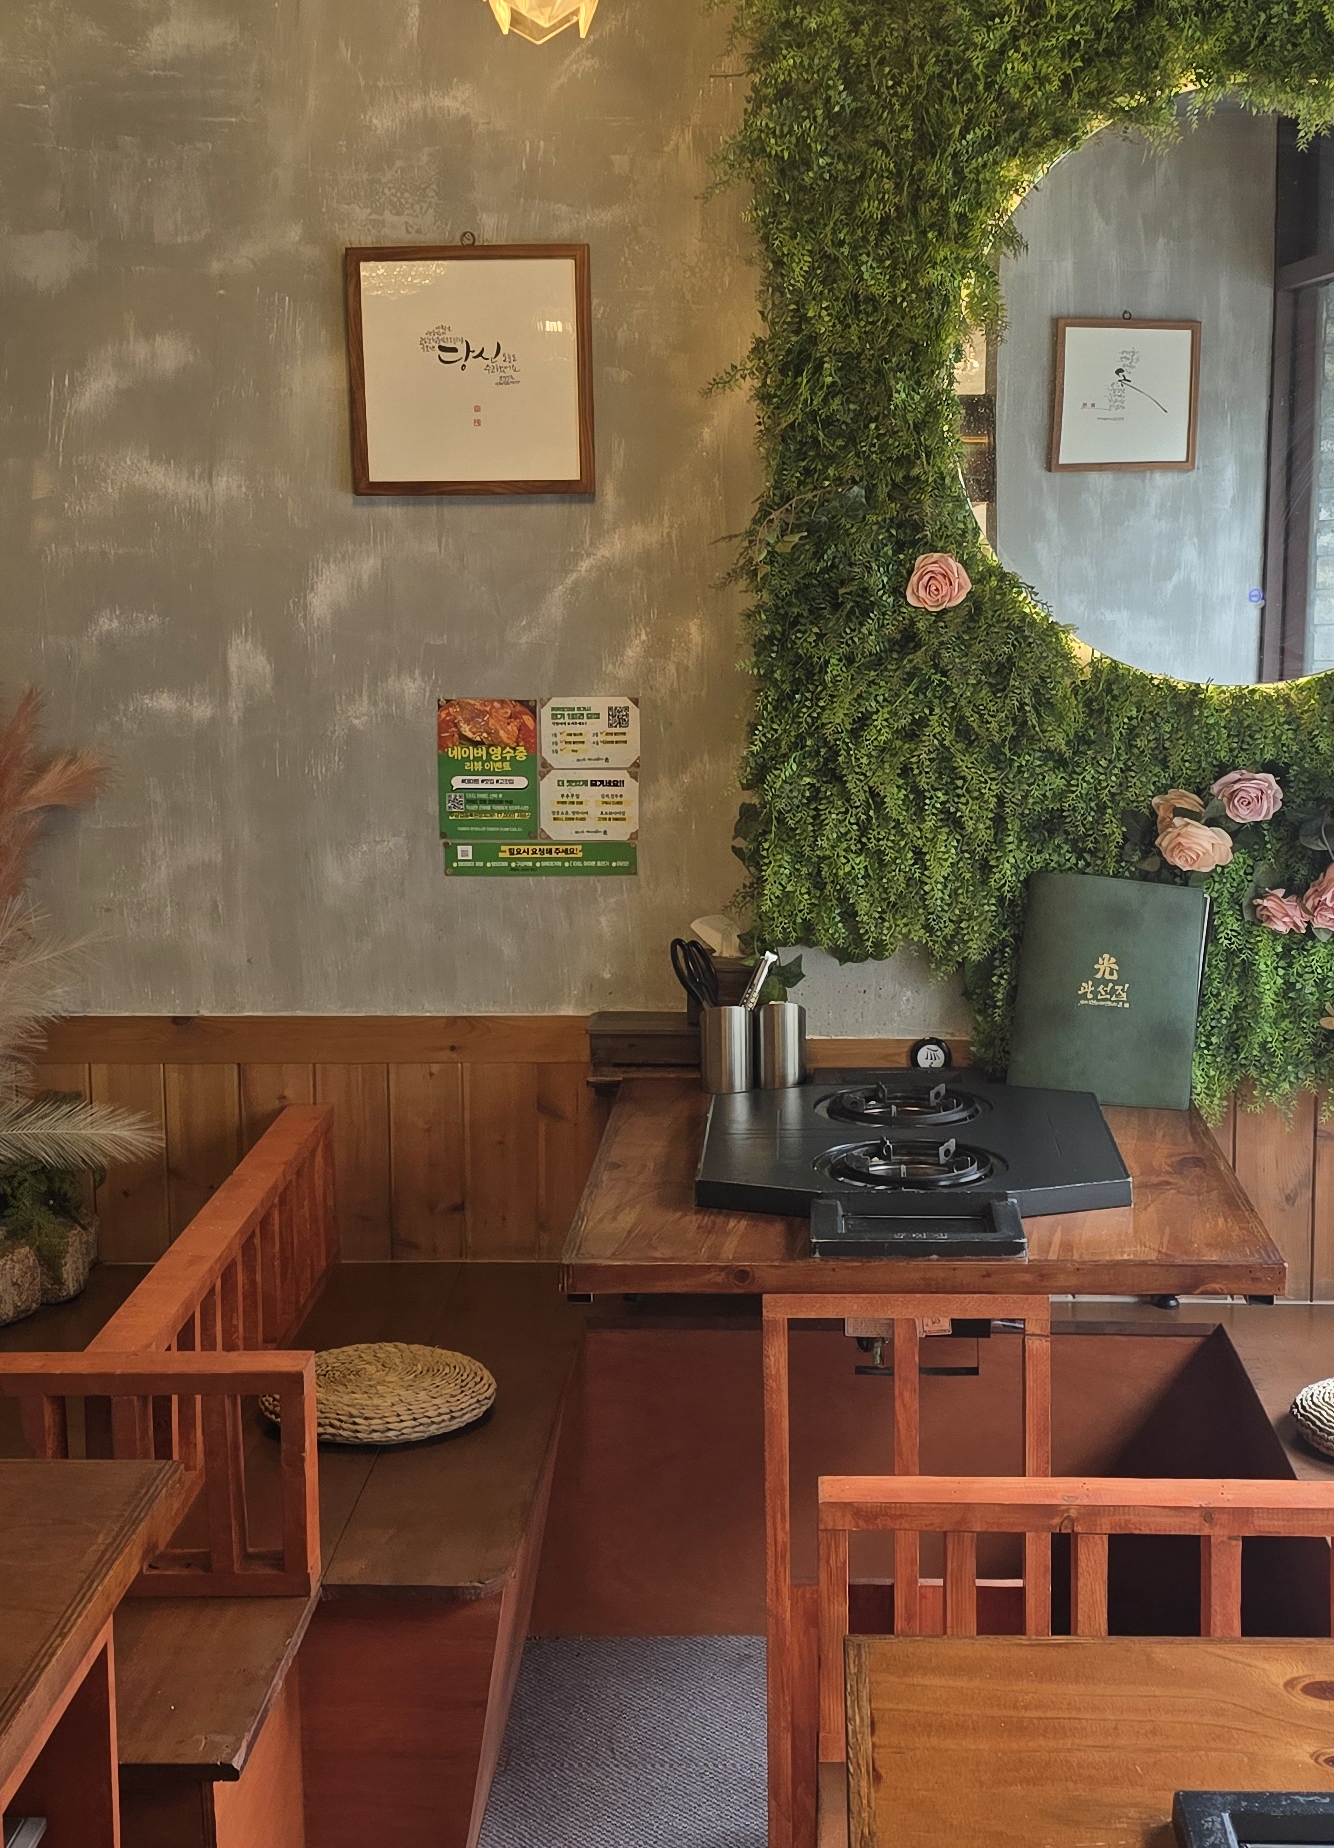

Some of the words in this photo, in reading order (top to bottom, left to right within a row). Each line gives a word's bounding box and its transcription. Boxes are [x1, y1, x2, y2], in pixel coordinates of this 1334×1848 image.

[437, 339, 501, 371] 당신
[447, 746, 487, 760] 네이버
[489, 746, 528, 761] 영수증
[464, 761, 483, 771] 리뷰
[484, 761, 512, 771] 이벤트
[508, 847, 530, 856] 필요시
[530, 847, 553, 856] 요청해
[553, 847, 579, 856] 주세요!
[1093, 953, 1120, 981] 光
